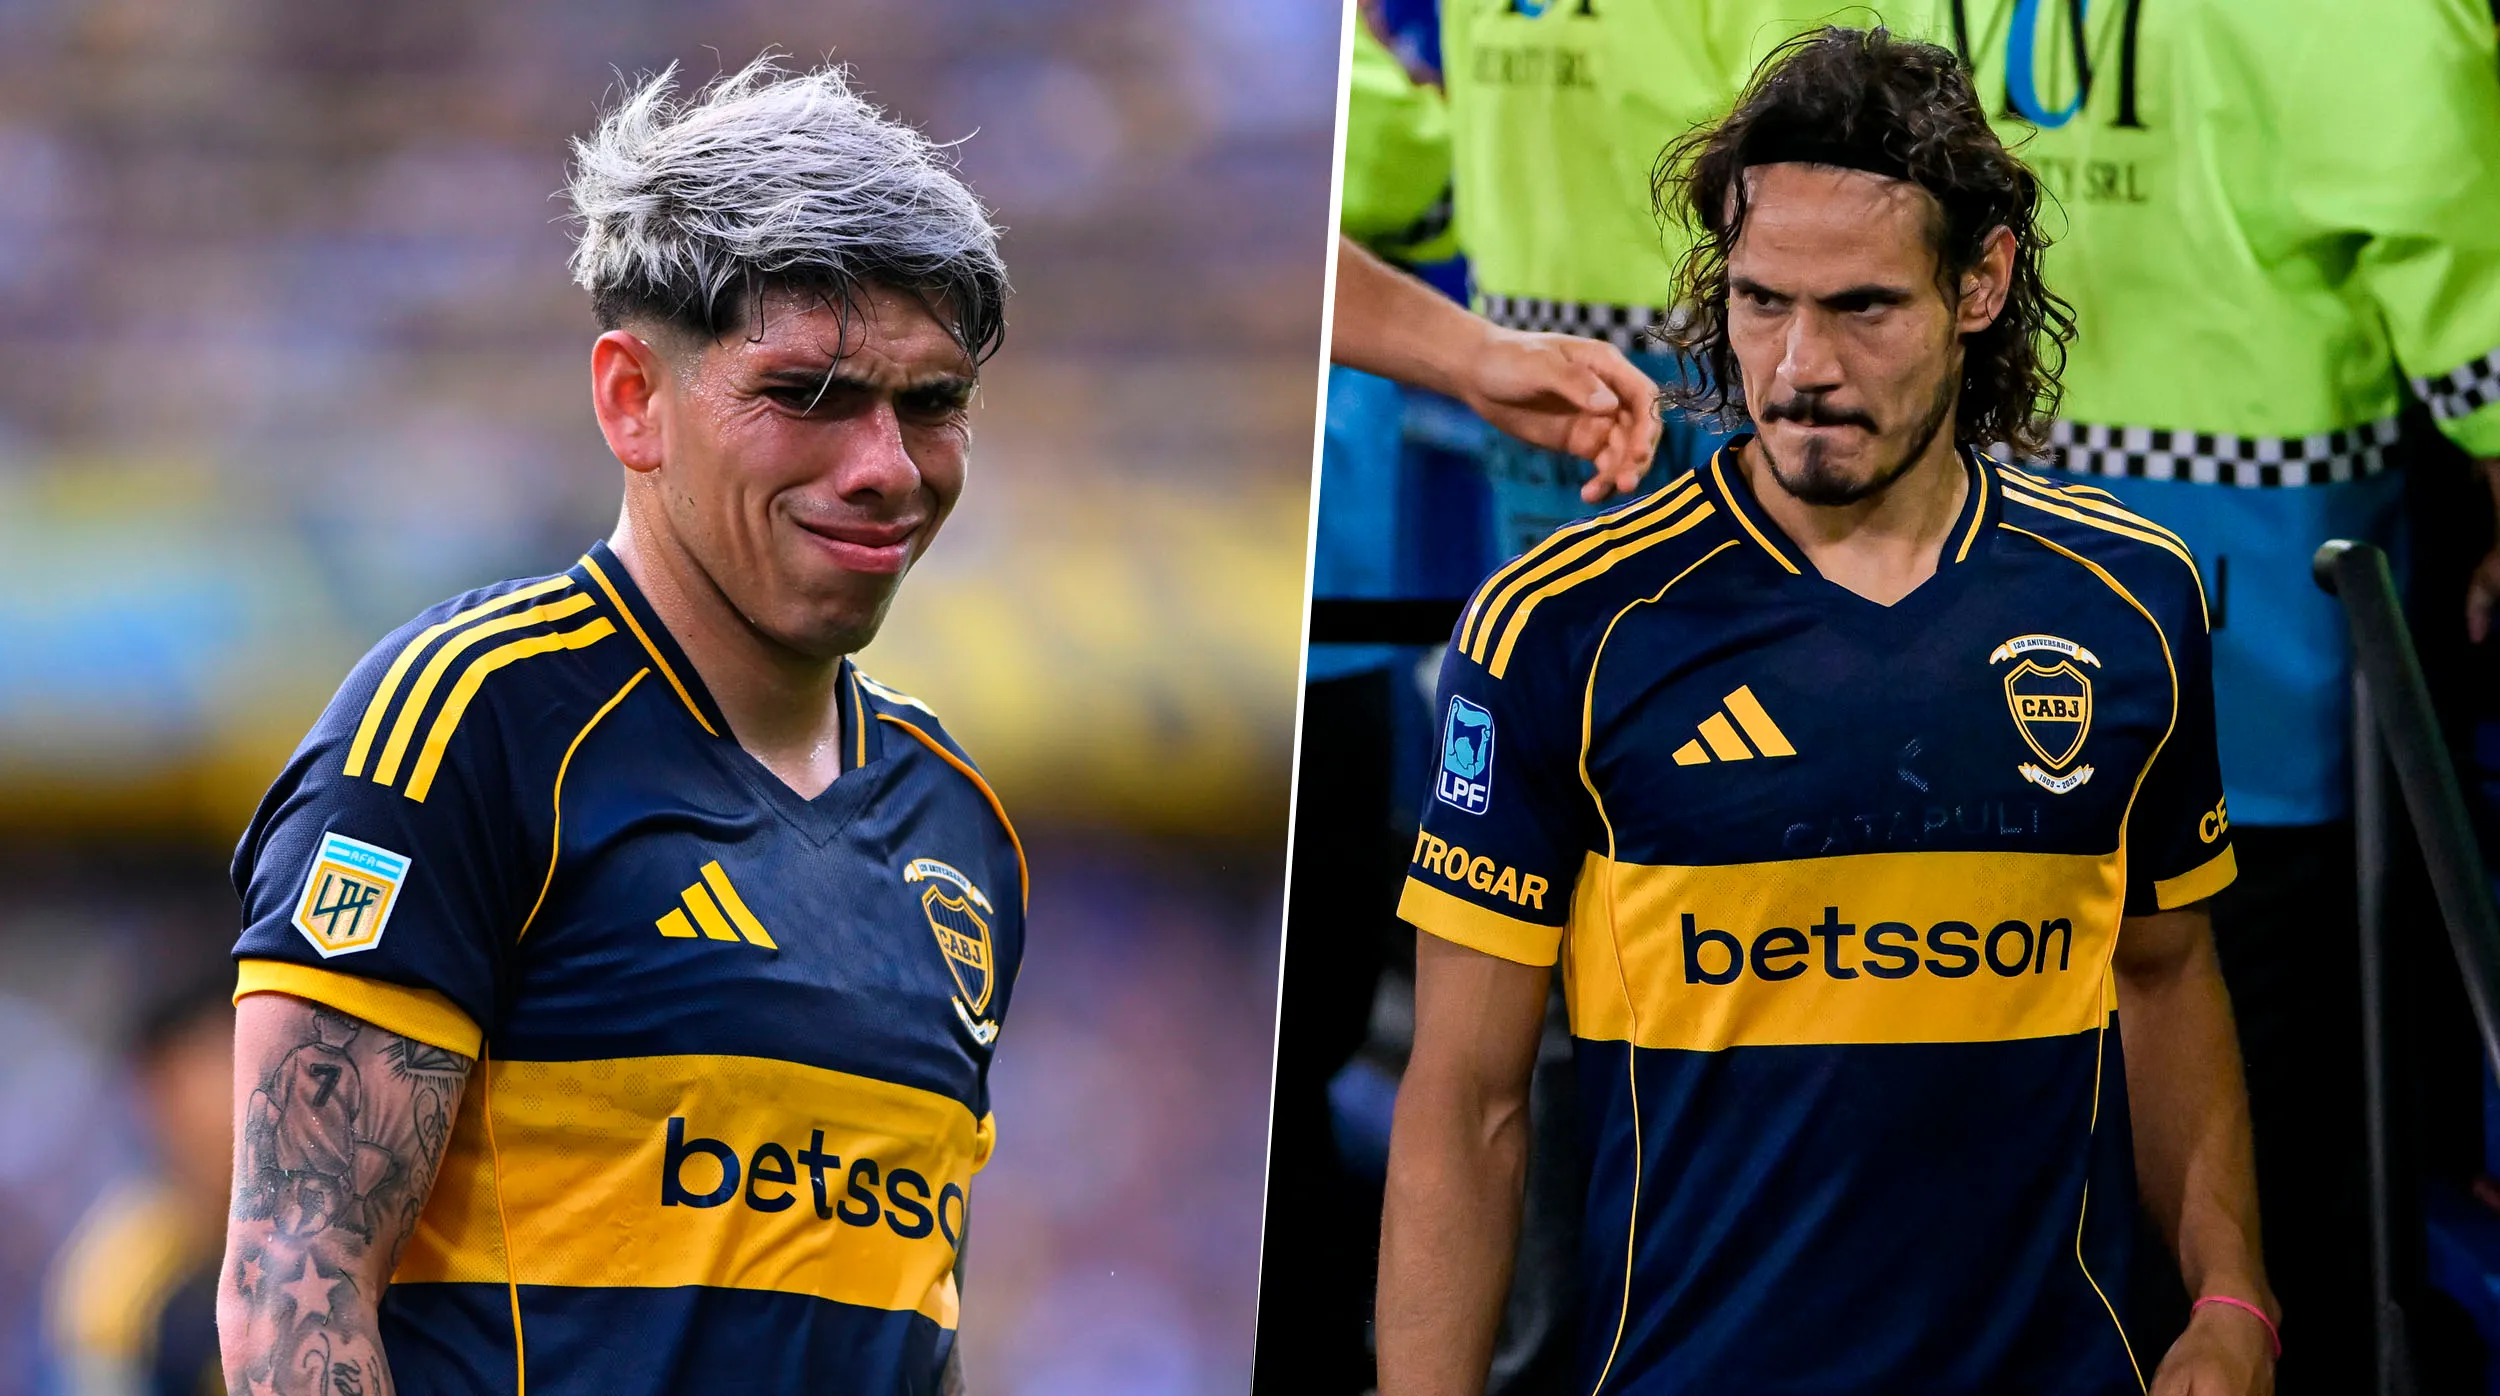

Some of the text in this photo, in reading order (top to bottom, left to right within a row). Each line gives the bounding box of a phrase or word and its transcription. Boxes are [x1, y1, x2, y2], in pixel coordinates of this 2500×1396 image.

[2012, 638, 2073, 652] 120 ANIVERSARIO
[2021, 699, 2080, 719] CABJ
[1440, 770, 1487, 809] LPF
[2061, 775, 2078, 790] 2025
[349, 850, 377, 867] AFA
[938, 928, 982, 965] CABJ
[1680, 905, 2073, 986] betsson
[310, 1062, 342, 1108] 7
